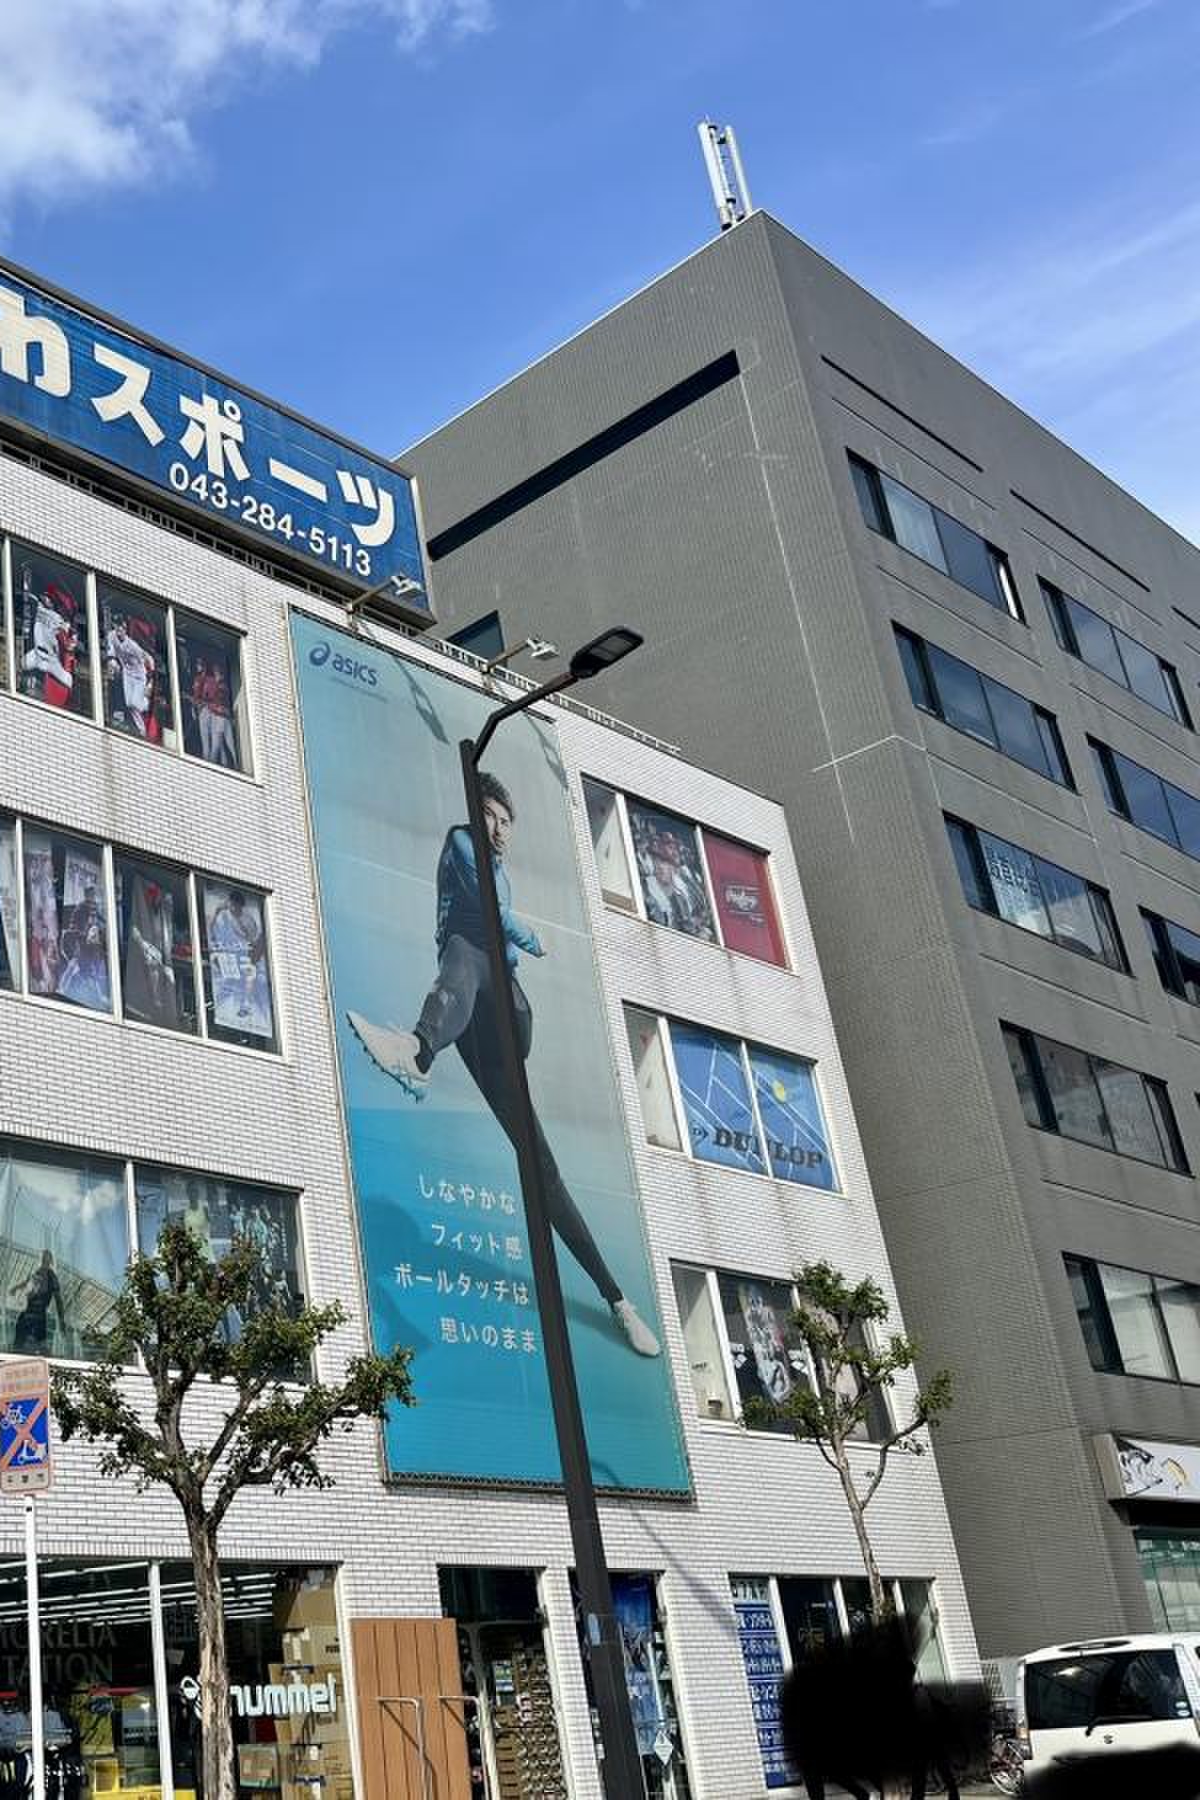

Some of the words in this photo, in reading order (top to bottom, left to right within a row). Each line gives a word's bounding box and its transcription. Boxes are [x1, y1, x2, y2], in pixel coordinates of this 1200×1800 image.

[169, 462, 371, 577] 043-284-5113
[332, 653, 378, 687] asics
[419, 1173, 516, 1216] しなやかな
[431, 1223, 524, 1261] フィット感
[394, 1263, 529, 1305] ボールタッチは
[440, 1317, 536, 1352] 思いのまま
